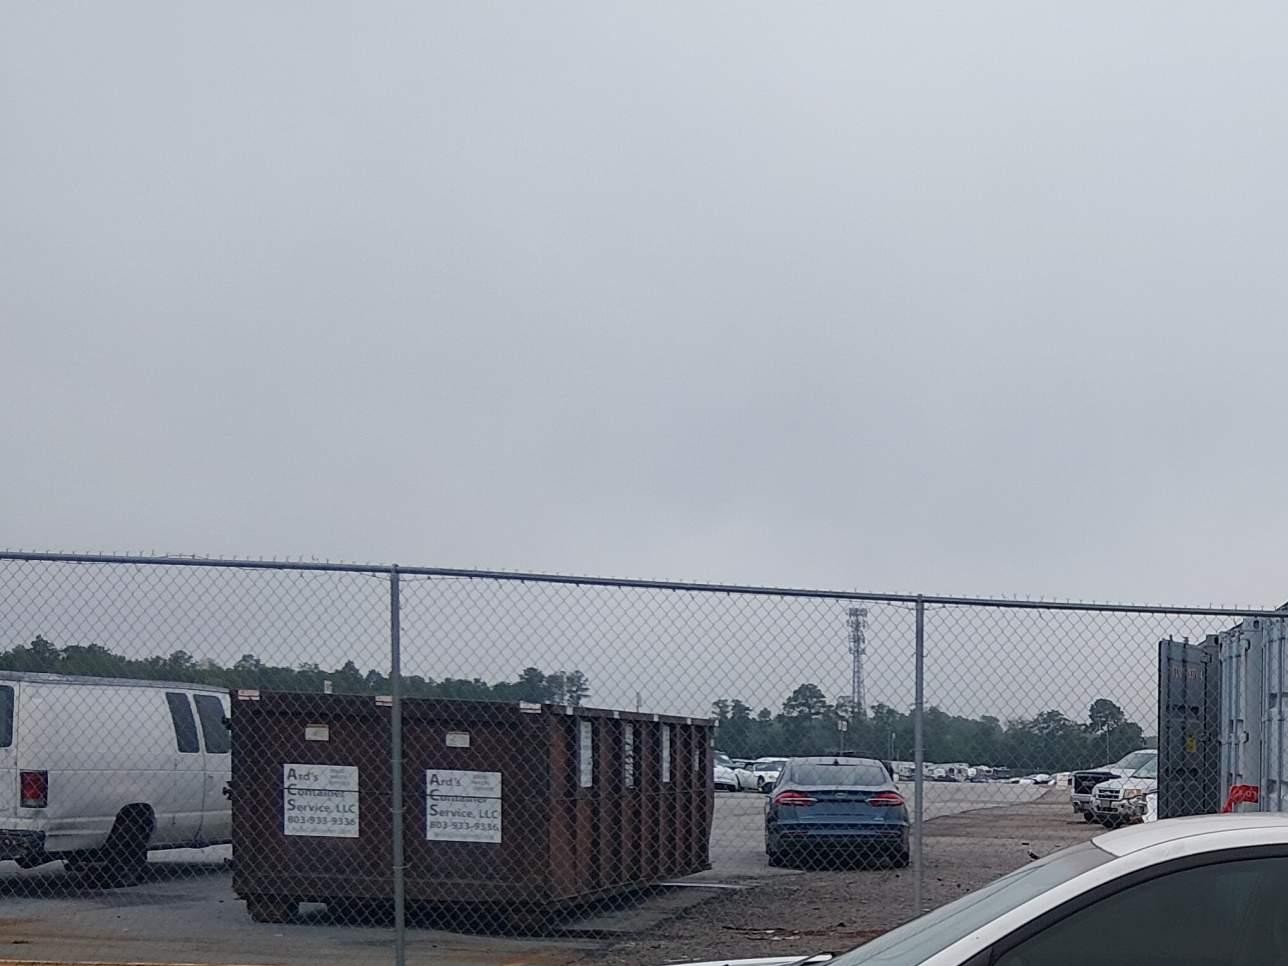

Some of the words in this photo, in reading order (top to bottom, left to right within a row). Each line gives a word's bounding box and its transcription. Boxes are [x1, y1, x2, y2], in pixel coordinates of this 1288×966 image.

[287, 768, 319, 782] Ard's
[430, 774, 462, 787] Ard's
[336, 804, 356, 814] LLC
[479, 809, 499, 819] LLC
